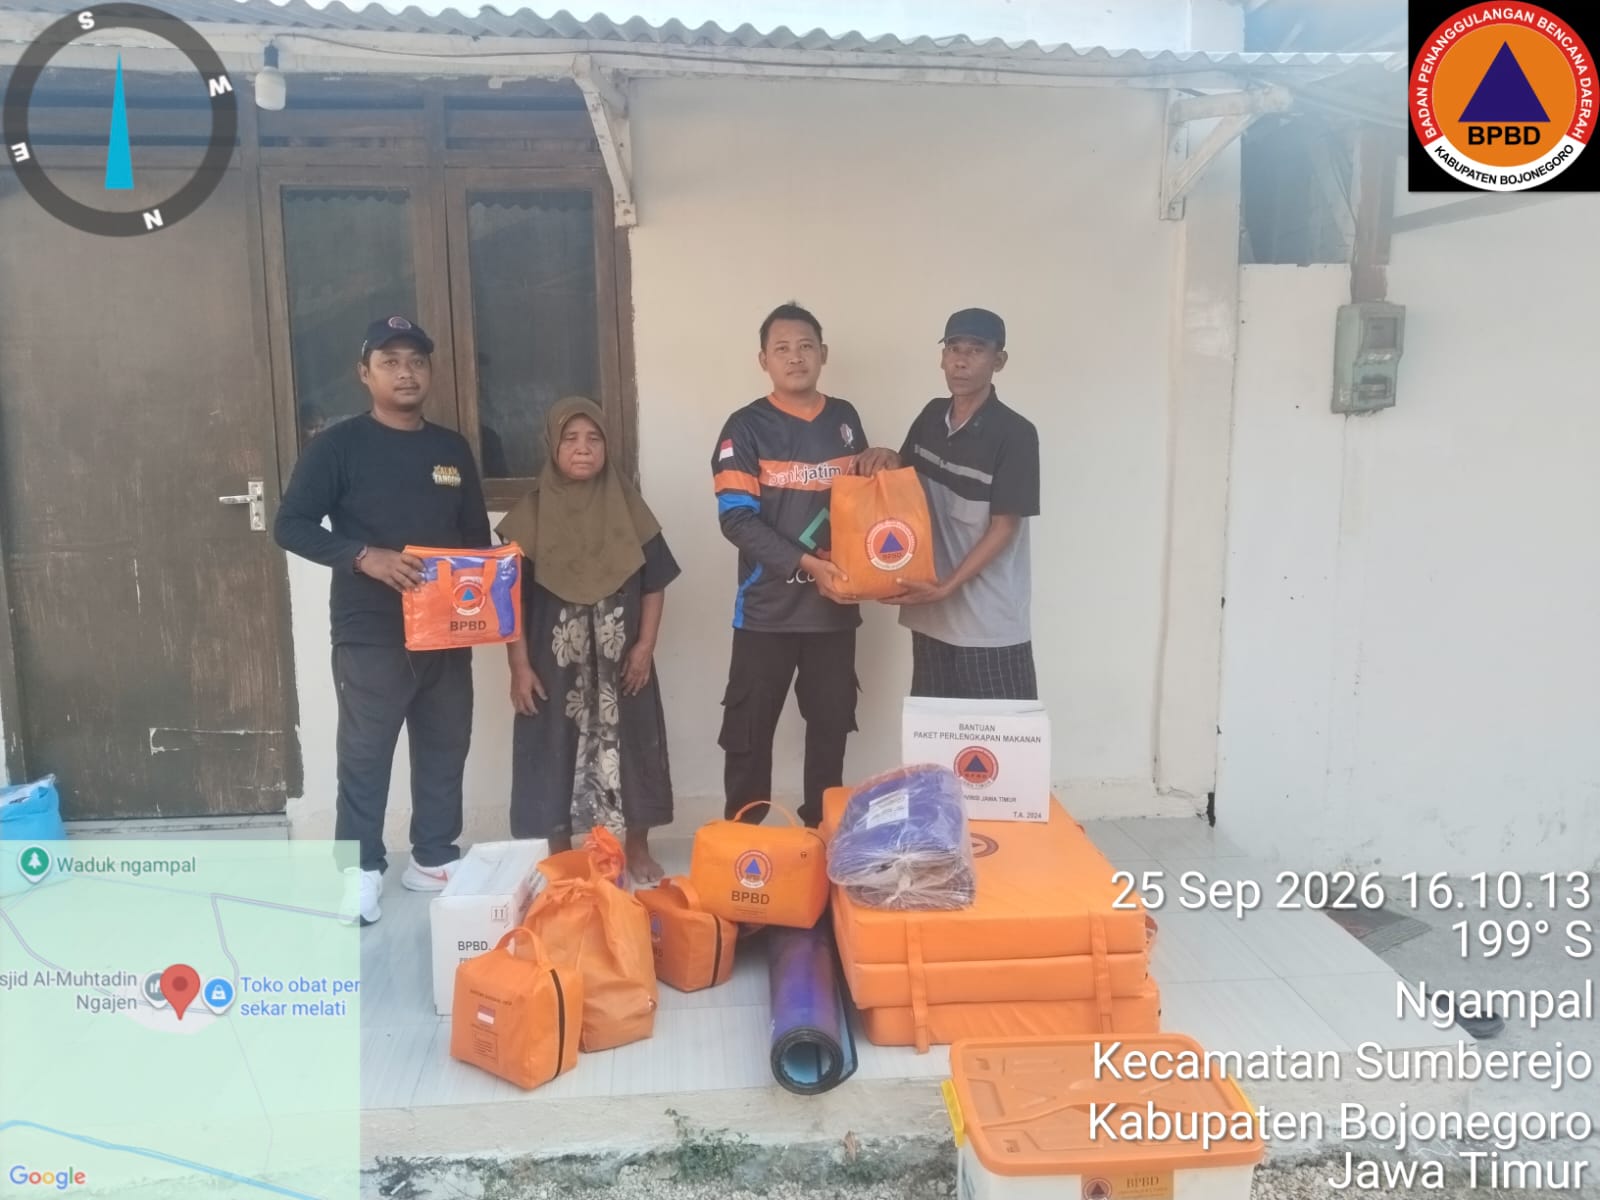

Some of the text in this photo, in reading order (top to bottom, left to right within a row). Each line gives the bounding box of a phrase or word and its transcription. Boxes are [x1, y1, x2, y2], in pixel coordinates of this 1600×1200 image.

[450, 620, 487, 631] BPBD
[959, 723, 996, 732] BANTUAN
[913, 731, 1041, 744] PAKET PERLENGKAPAN MAKANAN
[731, 890, 770, 905] BPBD
[1127, 1176, 1159, 1188] BPBD
